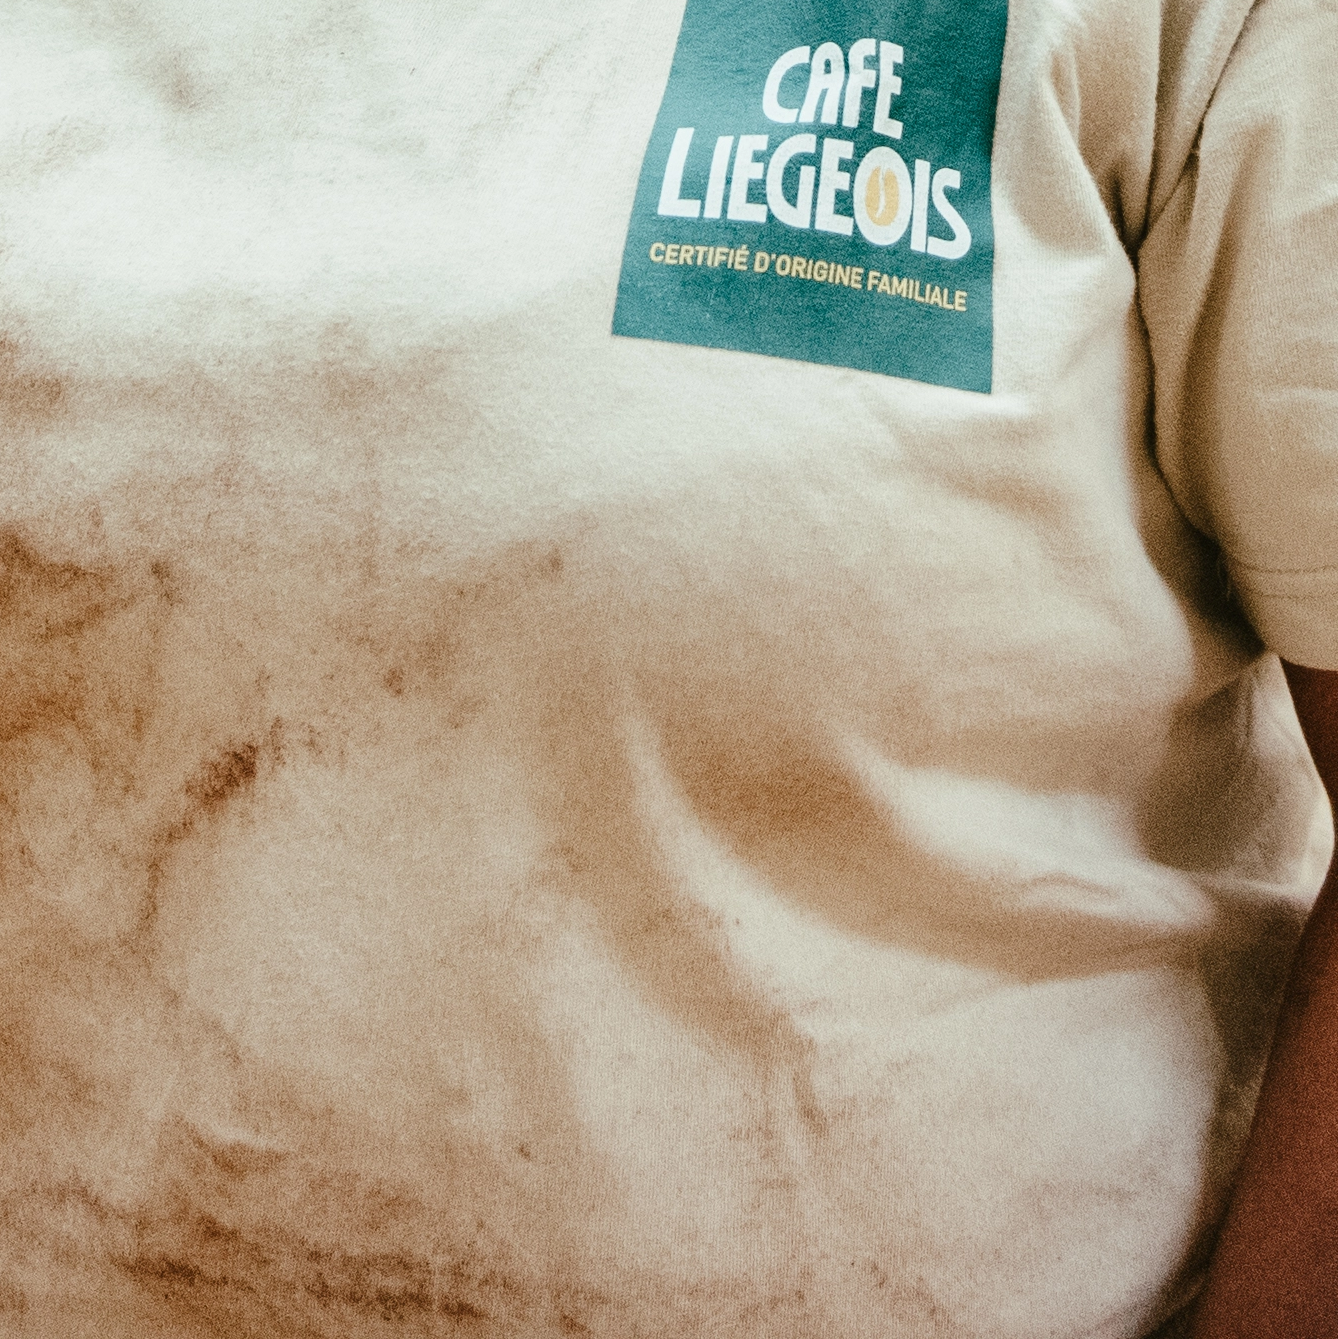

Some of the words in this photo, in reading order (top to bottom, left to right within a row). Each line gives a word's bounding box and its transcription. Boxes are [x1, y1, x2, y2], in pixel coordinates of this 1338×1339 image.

[762, 38, 904, 140] CAFE
[657, 127, 972, 260] LIEGEOIS
[649, 242, 748, 271] CERTIFIÉ
[753, 250, 863, 290] D'ORIGINE
[867, 269, 968, 312] FAMILIALE
